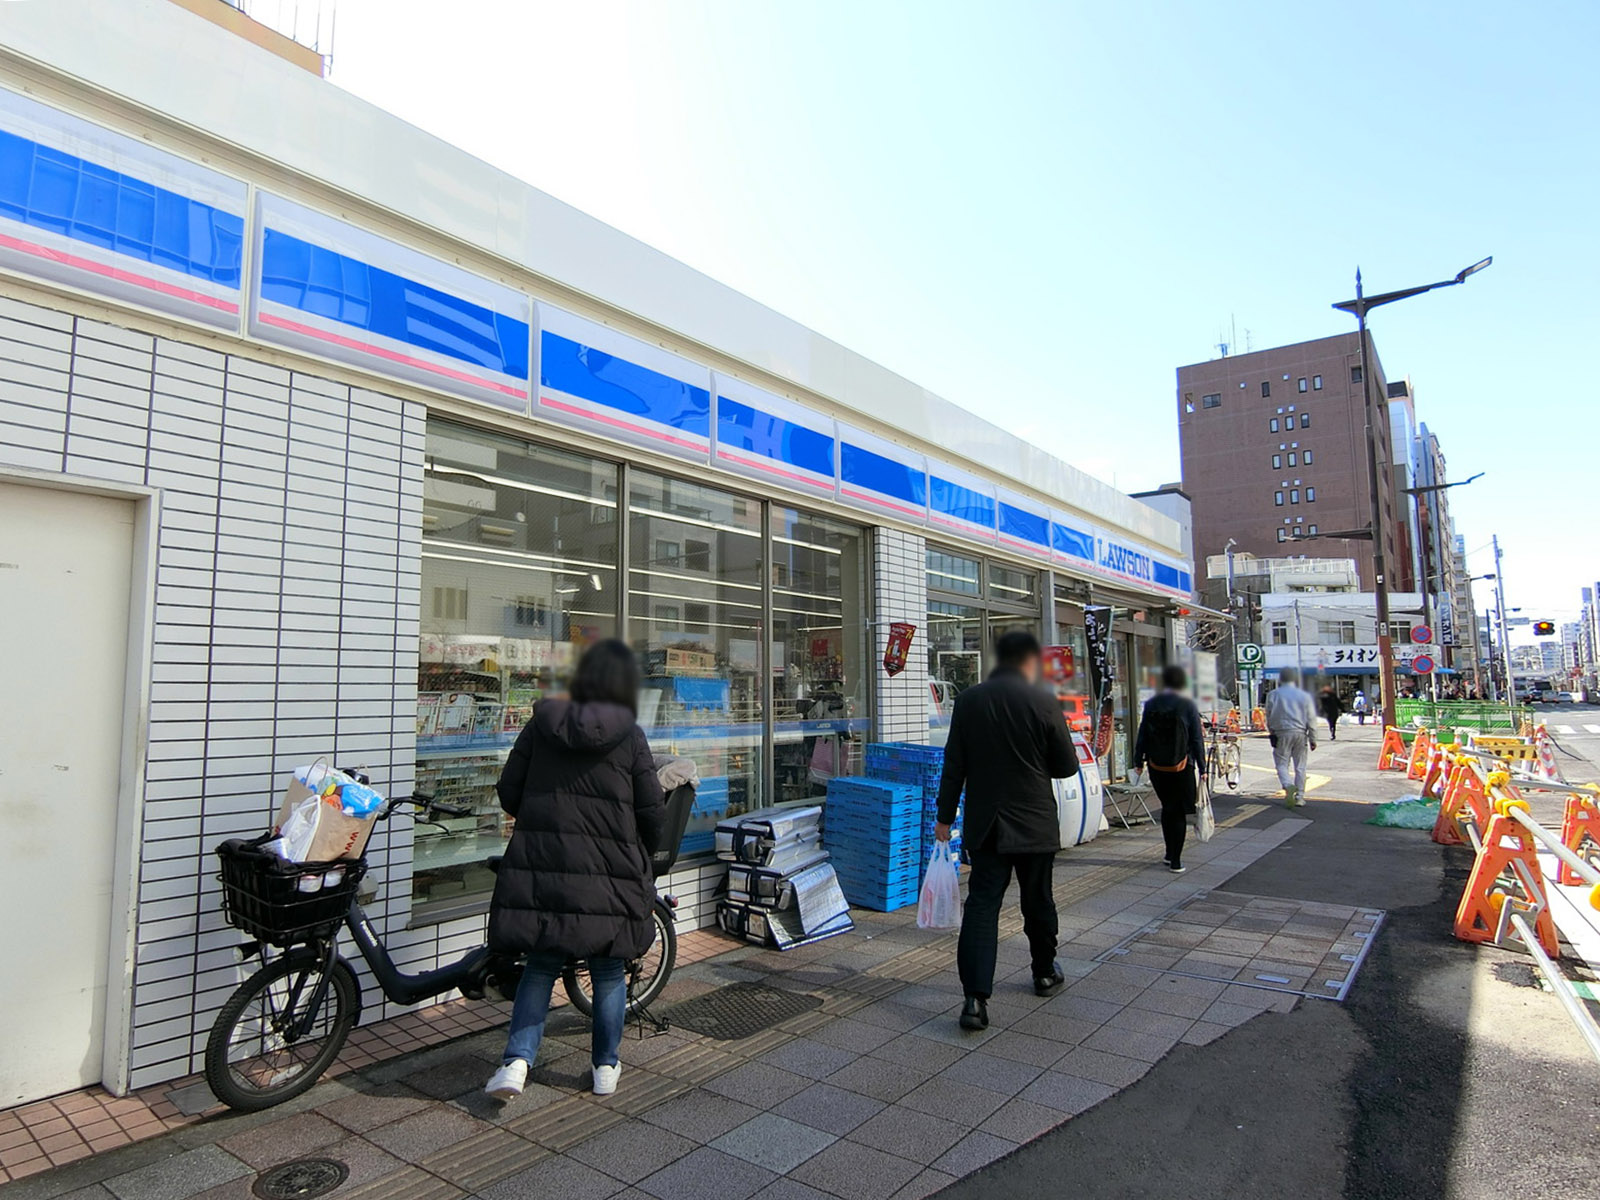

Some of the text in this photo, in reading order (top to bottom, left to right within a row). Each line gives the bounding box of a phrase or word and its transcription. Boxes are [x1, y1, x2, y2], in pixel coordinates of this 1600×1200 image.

[1097, 538, 1150, 581] LAWSON
[1246, 647, 1257, 660] P
[1334, 648, 1377, 663] ライオン
